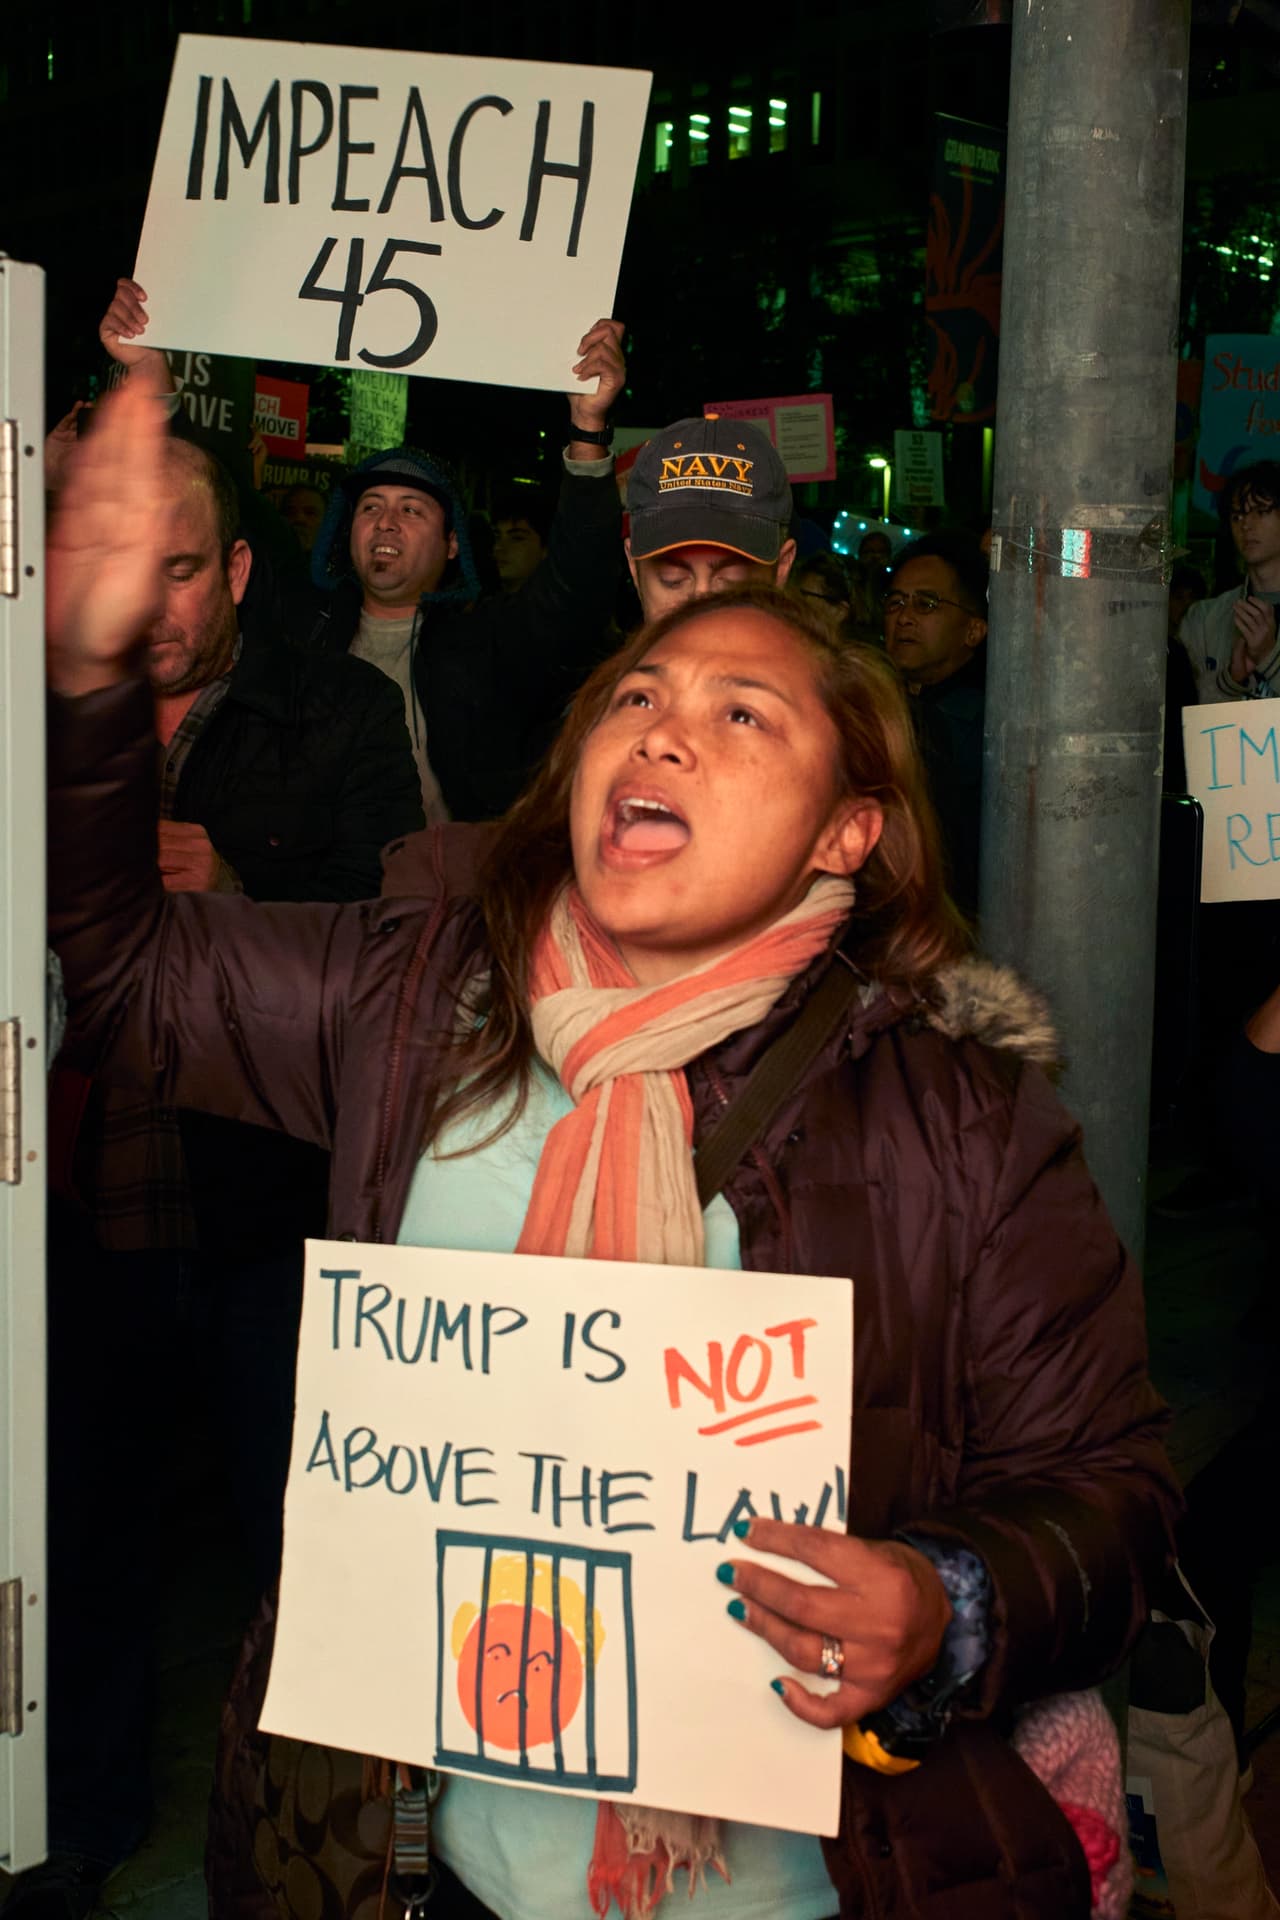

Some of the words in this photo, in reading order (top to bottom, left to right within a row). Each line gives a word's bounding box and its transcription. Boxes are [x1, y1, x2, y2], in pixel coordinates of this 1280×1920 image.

[186, 75, 595, 257] IMPEACH
[299, 237, 442, 369] 45
[183, 351, 212, 387] IS
[1212, 352, 1280, 392] Stud
[256, 397, 277, 414] CH
[255, 415, 297, 438] MOVE
[263, 464, 309, 486] RUMP
[659, 456, 753, 482] NAVY
[660, 480, 691, 490] United
[694, 479, 727, 488] States
[729, 482, 753, 494] Navy
[1199, 723, 1280, 790] IM
[1226, 813, 1280, 870] RE
[319, 1268, 528, 1374] TRUMP
[562, 1308, 627, 1383] IS
[664, 1318, 818, 1414] NOT
[306, 1411, 500, 1507] ABOVE
[519, 1452, 657, 1535] THE
